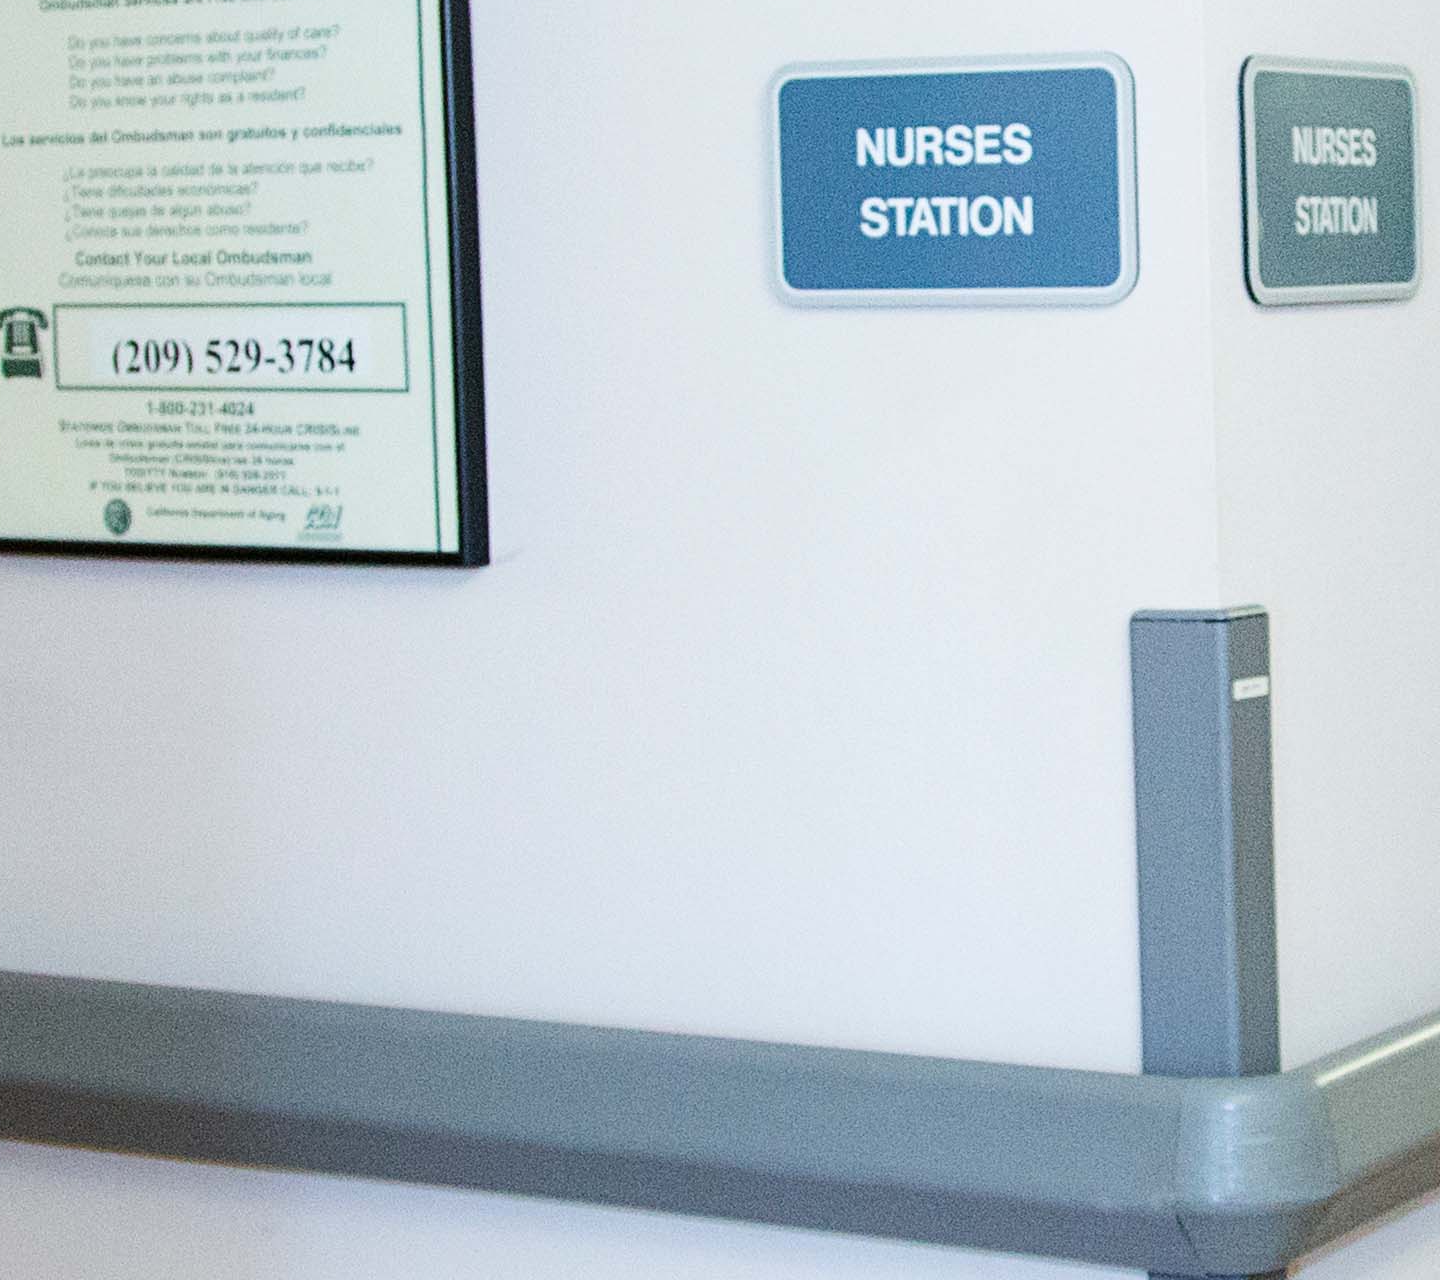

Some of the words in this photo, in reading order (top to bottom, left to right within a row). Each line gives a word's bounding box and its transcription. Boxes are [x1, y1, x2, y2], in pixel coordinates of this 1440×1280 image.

[855, 122, 1034, 168] NURSES
[1291, 125, 1377, 168] NURSES
[859, 195, 1035, 239] STATION
[1293, 194, 1379, 237] STATION
[74, 249, 130, 266] Contact
[134, 249, 168, 265] Your
[172, 249, 212, 265] Local
[216, 248, 313, 265] Ombudsman
[112, 337, 194, 376] (209)
[206, 337, 357, 375] 529-3784
